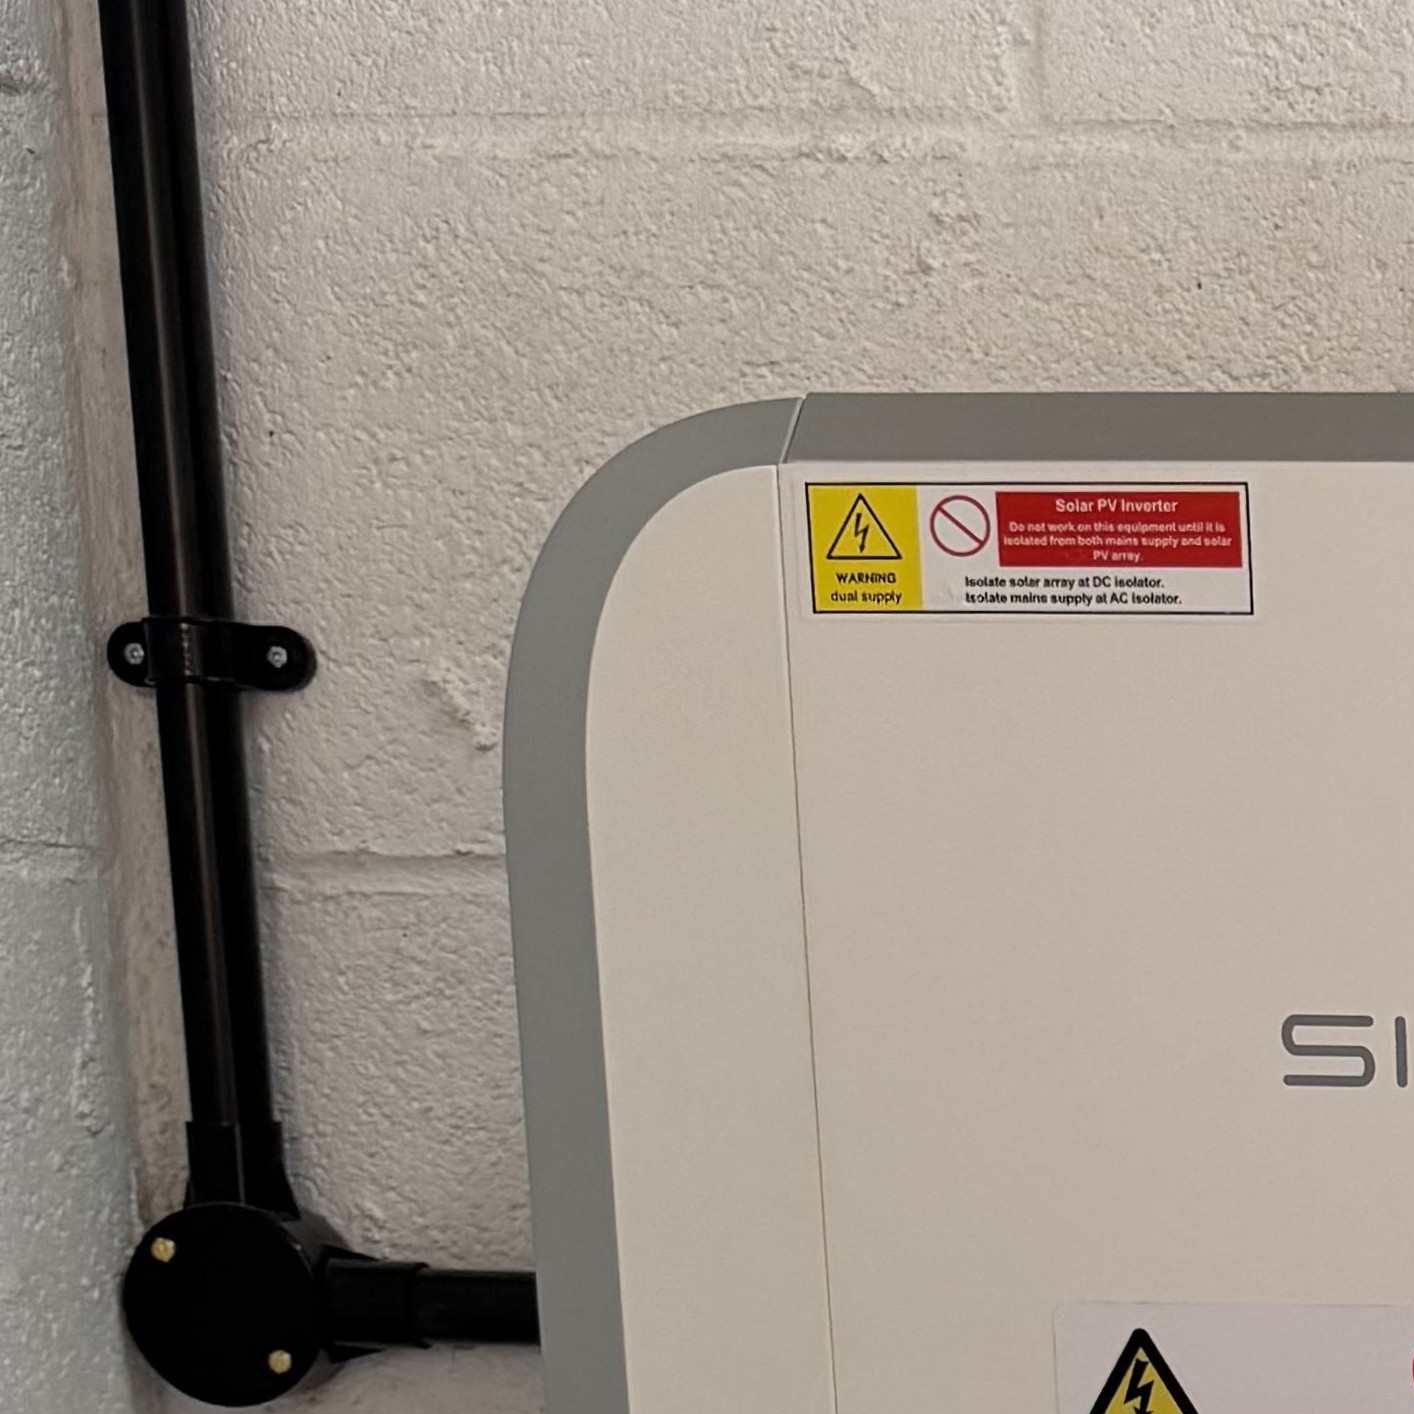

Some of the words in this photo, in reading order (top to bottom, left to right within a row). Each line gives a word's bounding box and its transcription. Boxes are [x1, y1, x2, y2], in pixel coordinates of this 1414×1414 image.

[1056, 499, 1093, 512] Solar
[1098, 499, 1117, 512] PV
[1122, 500, 1178, 512] Inverter
[1010, 522, 1025, 532] Do
[1028, 522, 1046, 532] not
[1048, 522, 1075, 532] work
[1078, 524, 1091, 532] on
[1094, 522, 1114, 532] this
[1117, 522, 1177, 533] equipment
[1179, 522, 1203, 532] until
[1206, 522, 1213, 532] it
[1216, 522, 1225, 532] is
[1004, 536, 1047, 545] isolated
[1050, 536, 1075, 545] from
[1079, 536, 1103, 546] both
[1106, 537, 1138, 546] mains
[1142, 537, 1177, 548] supply
[1181, 536, 1201, 546] and
[1204, 537, 1232, 546] solar
[1093, 551, 1109, 560] PV
[1112, 552, 1143, 562] array.
[836, 573, 896, 584] WARNING
[965, 576, 1006, 587] Isolate
[1009, 576, 1041, 587] solar
[1044, 578, 1075, 589] array
[1078, 578, 1090, 587] at
[1093, 576, 1111, 587] DC
[1115, 577, 1164, 588] isolator.
[831, 591, 859, 602] dual
[862, 592, 902, 605] supply
[965, 592, 1007, 603] Isolate
[1010, 593, 1047, 603] mains
[1051, 593, 1092, 606] supply
[1096, 593, 1107, 604] at
[1110, 593, 1128, 604] AC
